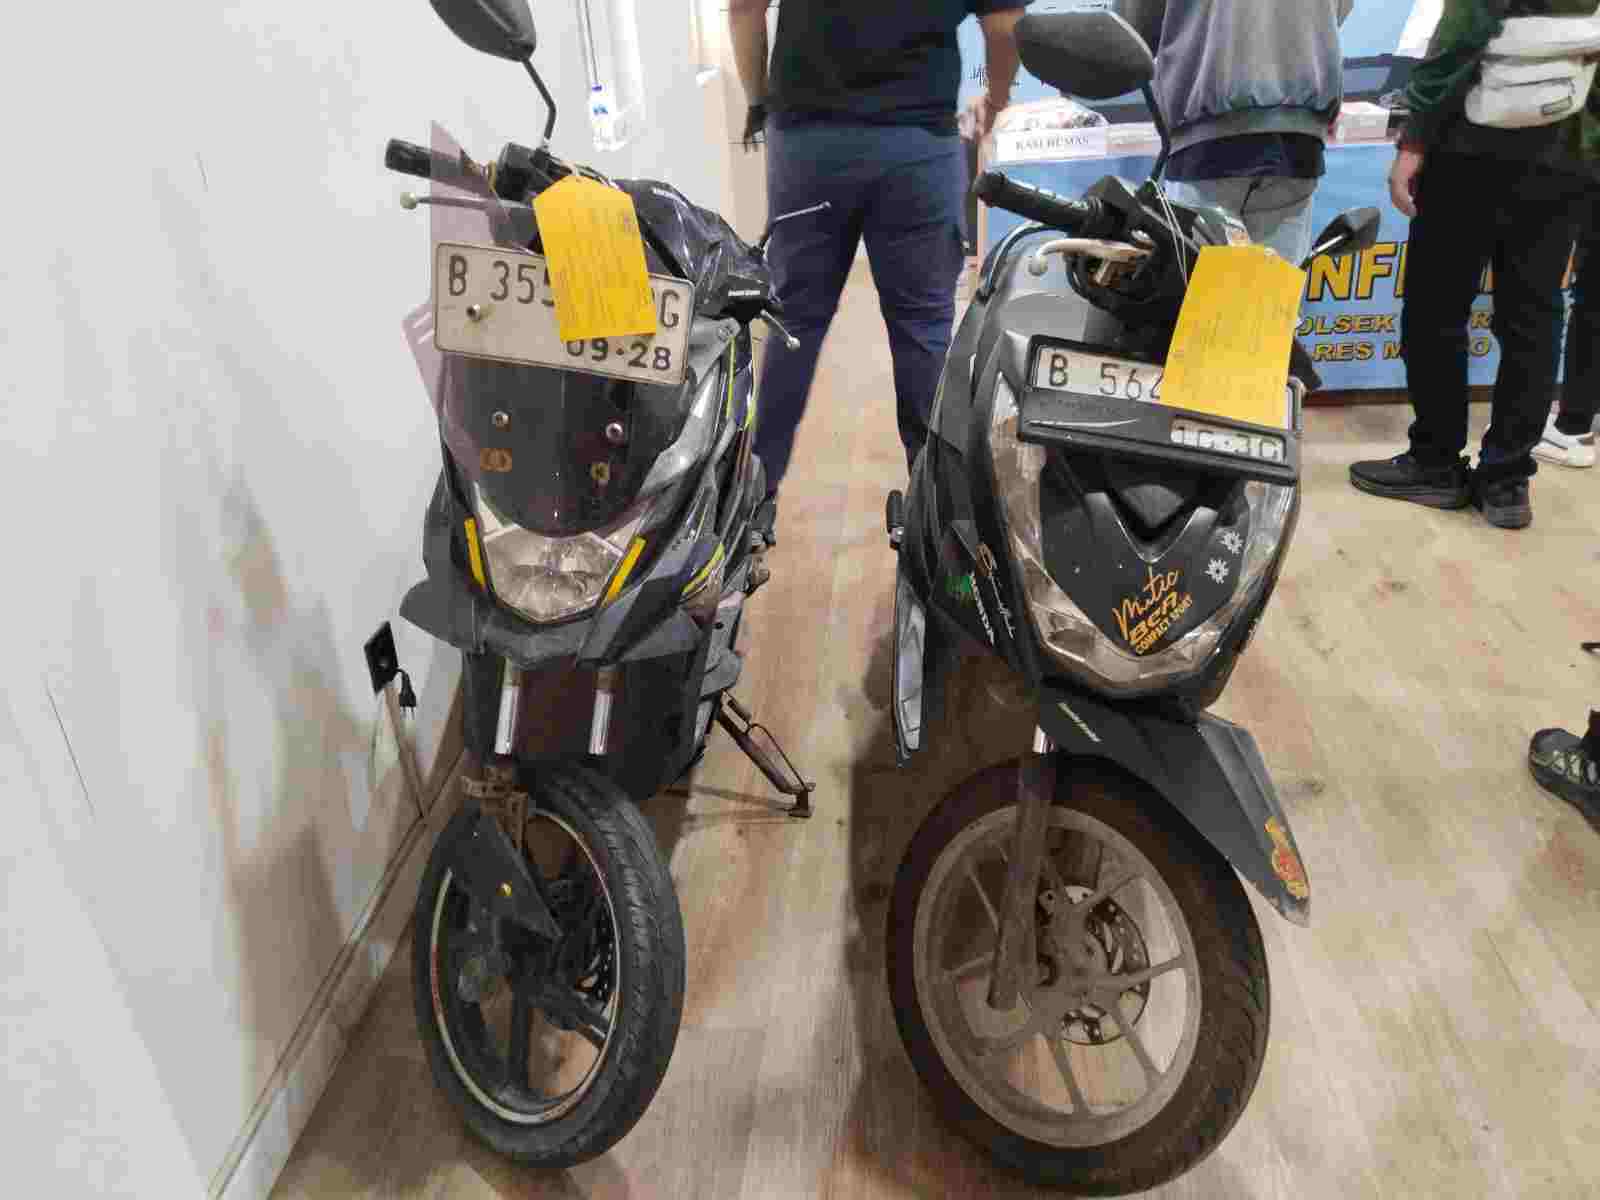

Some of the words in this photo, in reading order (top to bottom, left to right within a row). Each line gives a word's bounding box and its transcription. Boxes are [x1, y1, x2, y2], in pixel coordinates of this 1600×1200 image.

[448, 255, 468, 297] B
[1296, 313, 1397, 336] OLSEK
[1310, 341, 1376, 361] RES
[1049, 353, 1068, 387] B
